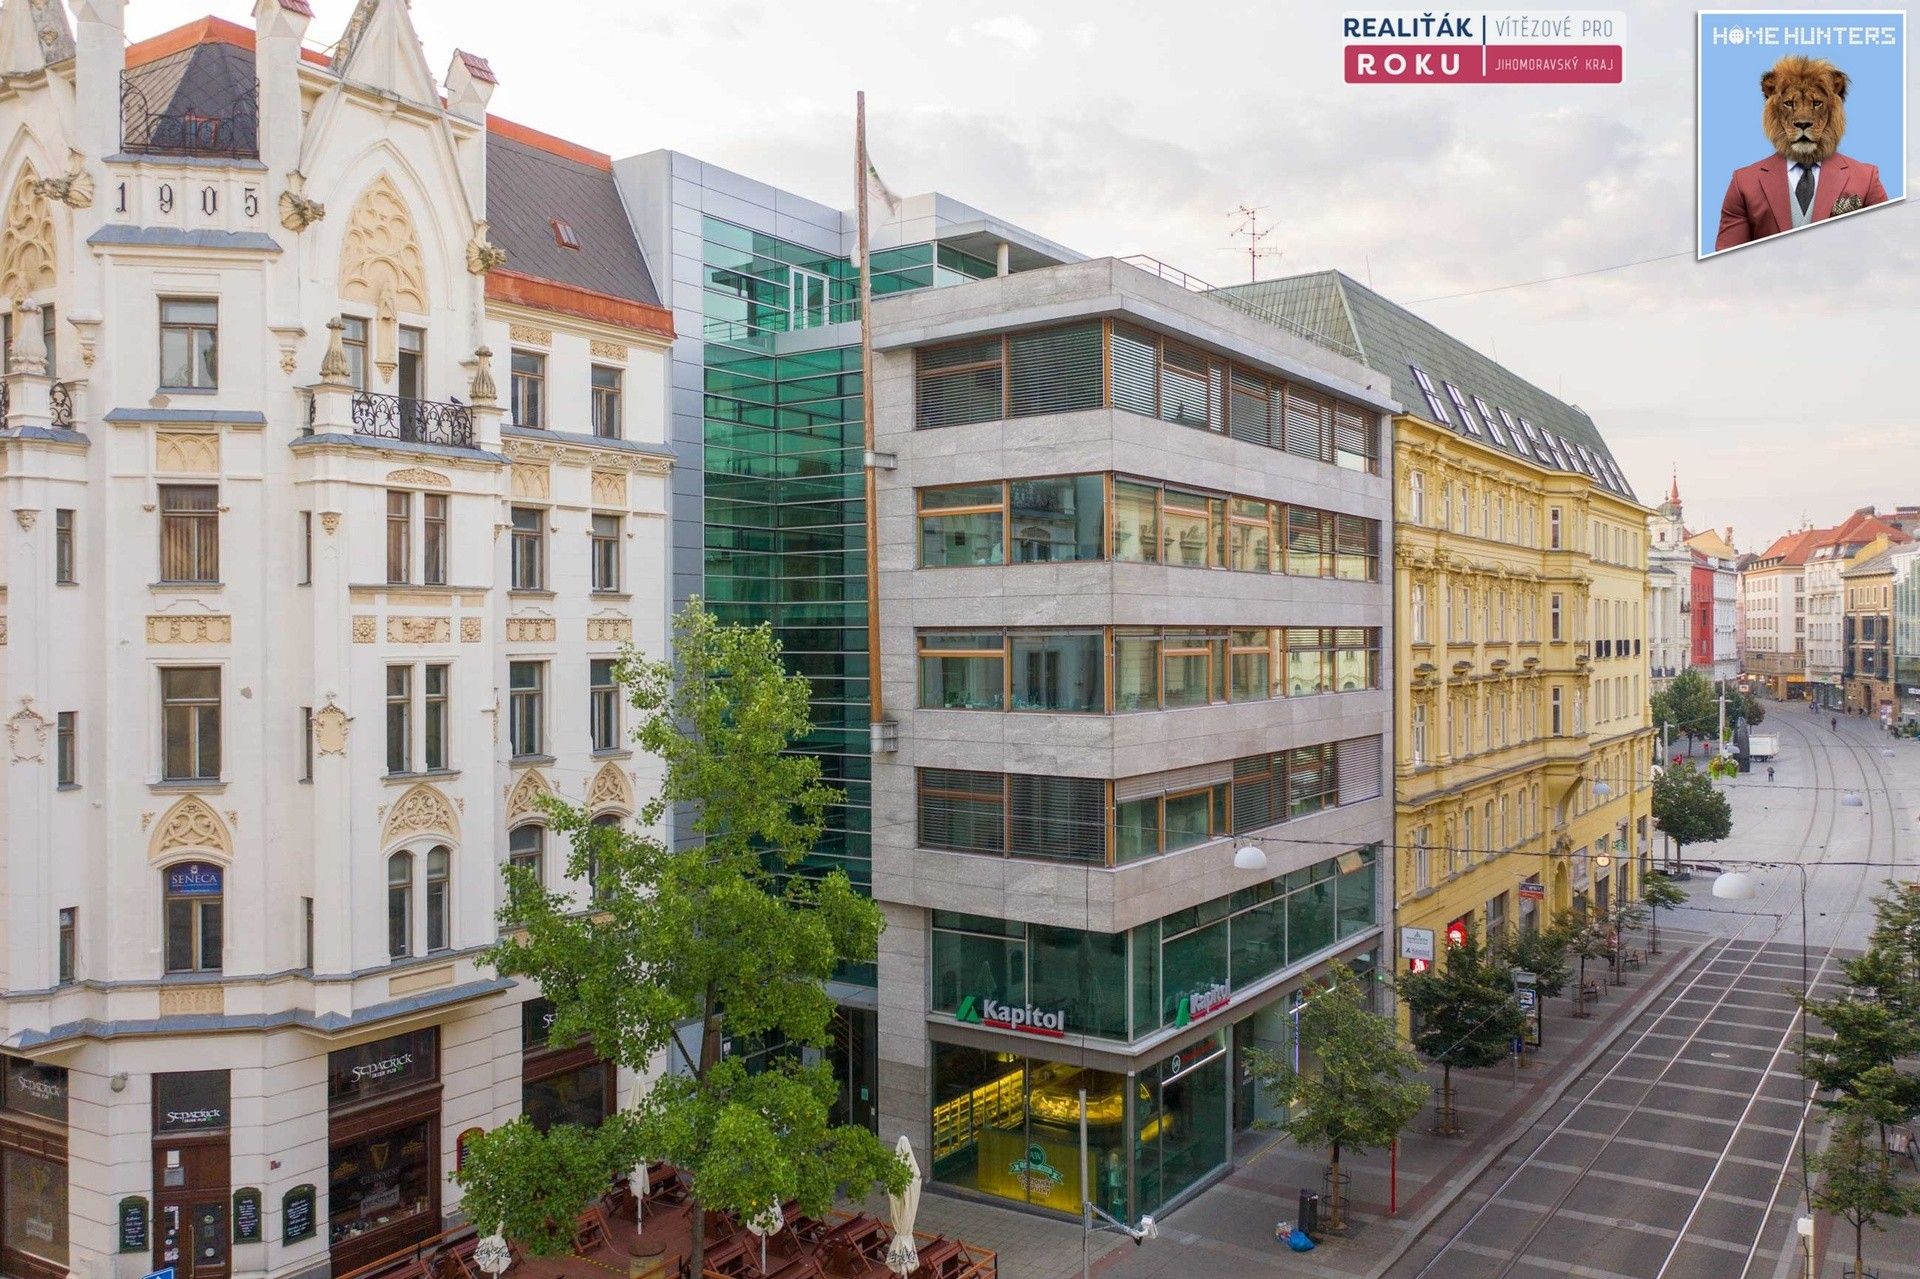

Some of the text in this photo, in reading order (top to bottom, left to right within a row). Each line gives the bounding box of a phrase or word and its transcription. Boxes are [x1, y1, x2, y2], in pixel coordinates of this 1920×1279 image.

[115, 181, 259, 218] 1905
[172, 874, 217, 884] SENECA
[1190, 978, 1231, 1014] Kapitol
[983, 998, 1065, 1030] Kapitol
